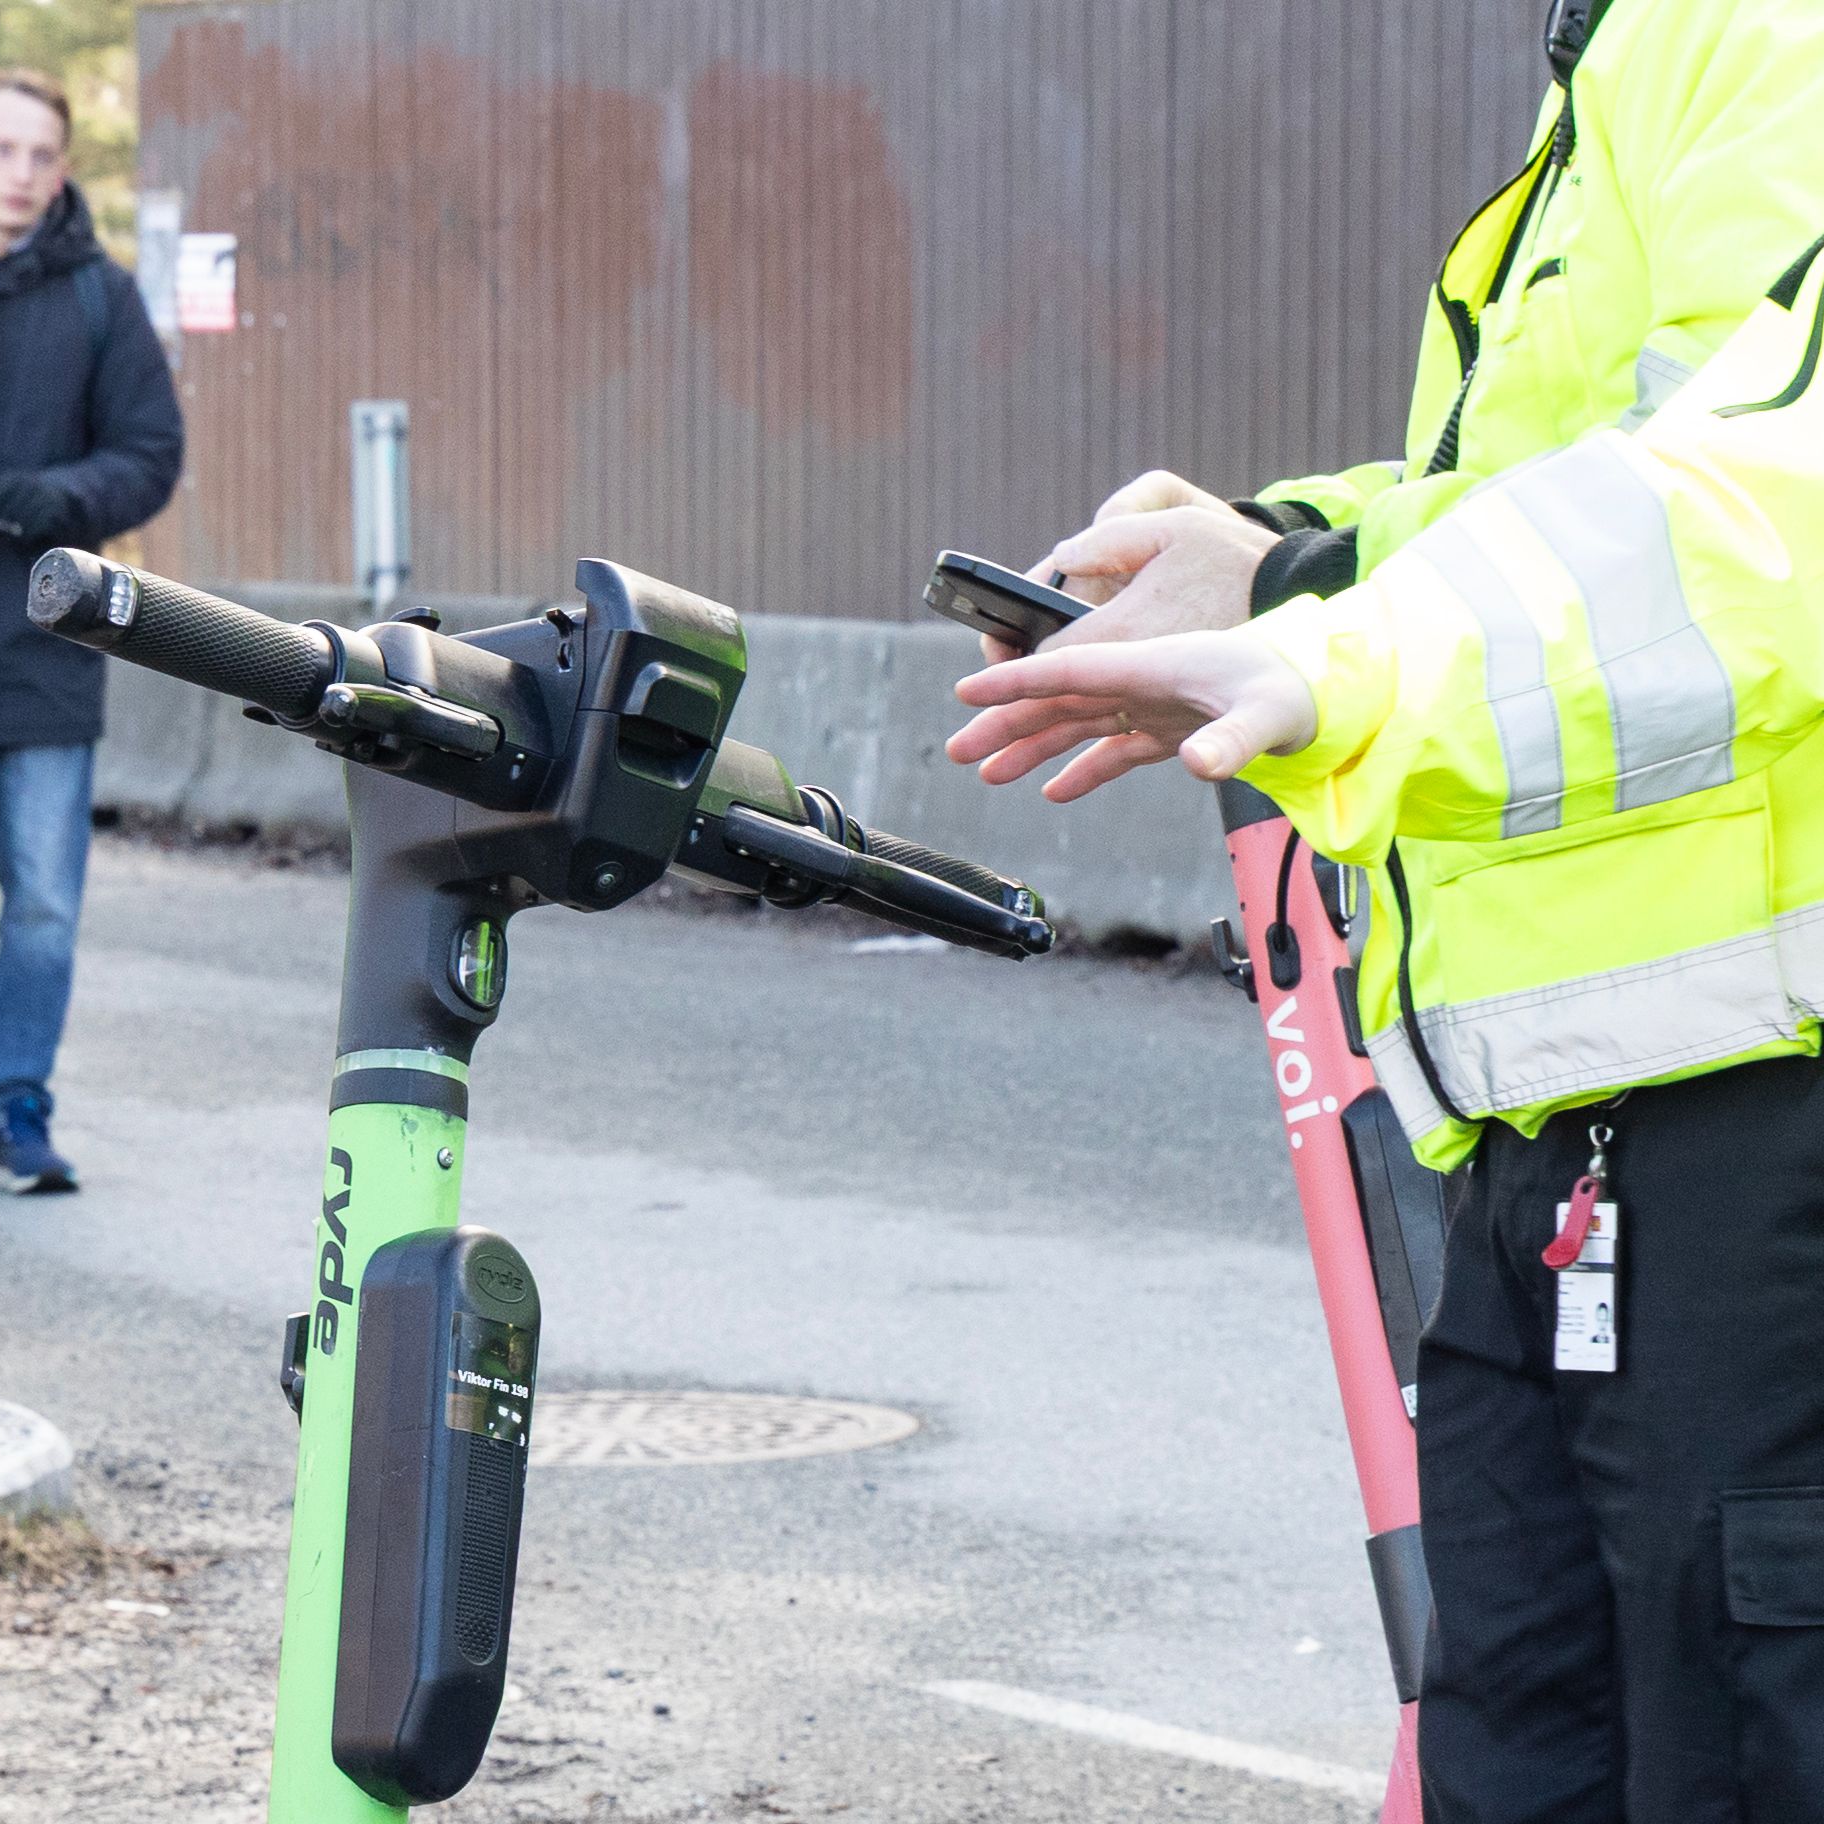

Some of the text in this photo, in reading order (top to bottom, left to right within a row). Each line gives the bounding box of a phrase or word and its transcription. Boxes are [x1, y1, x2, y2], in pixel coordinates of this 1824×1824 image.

[312, 1145, 354, 1356] ryde
[457, 1368, 493, 1388] Viktor
[492, 1377, 510, 1394] Fin
